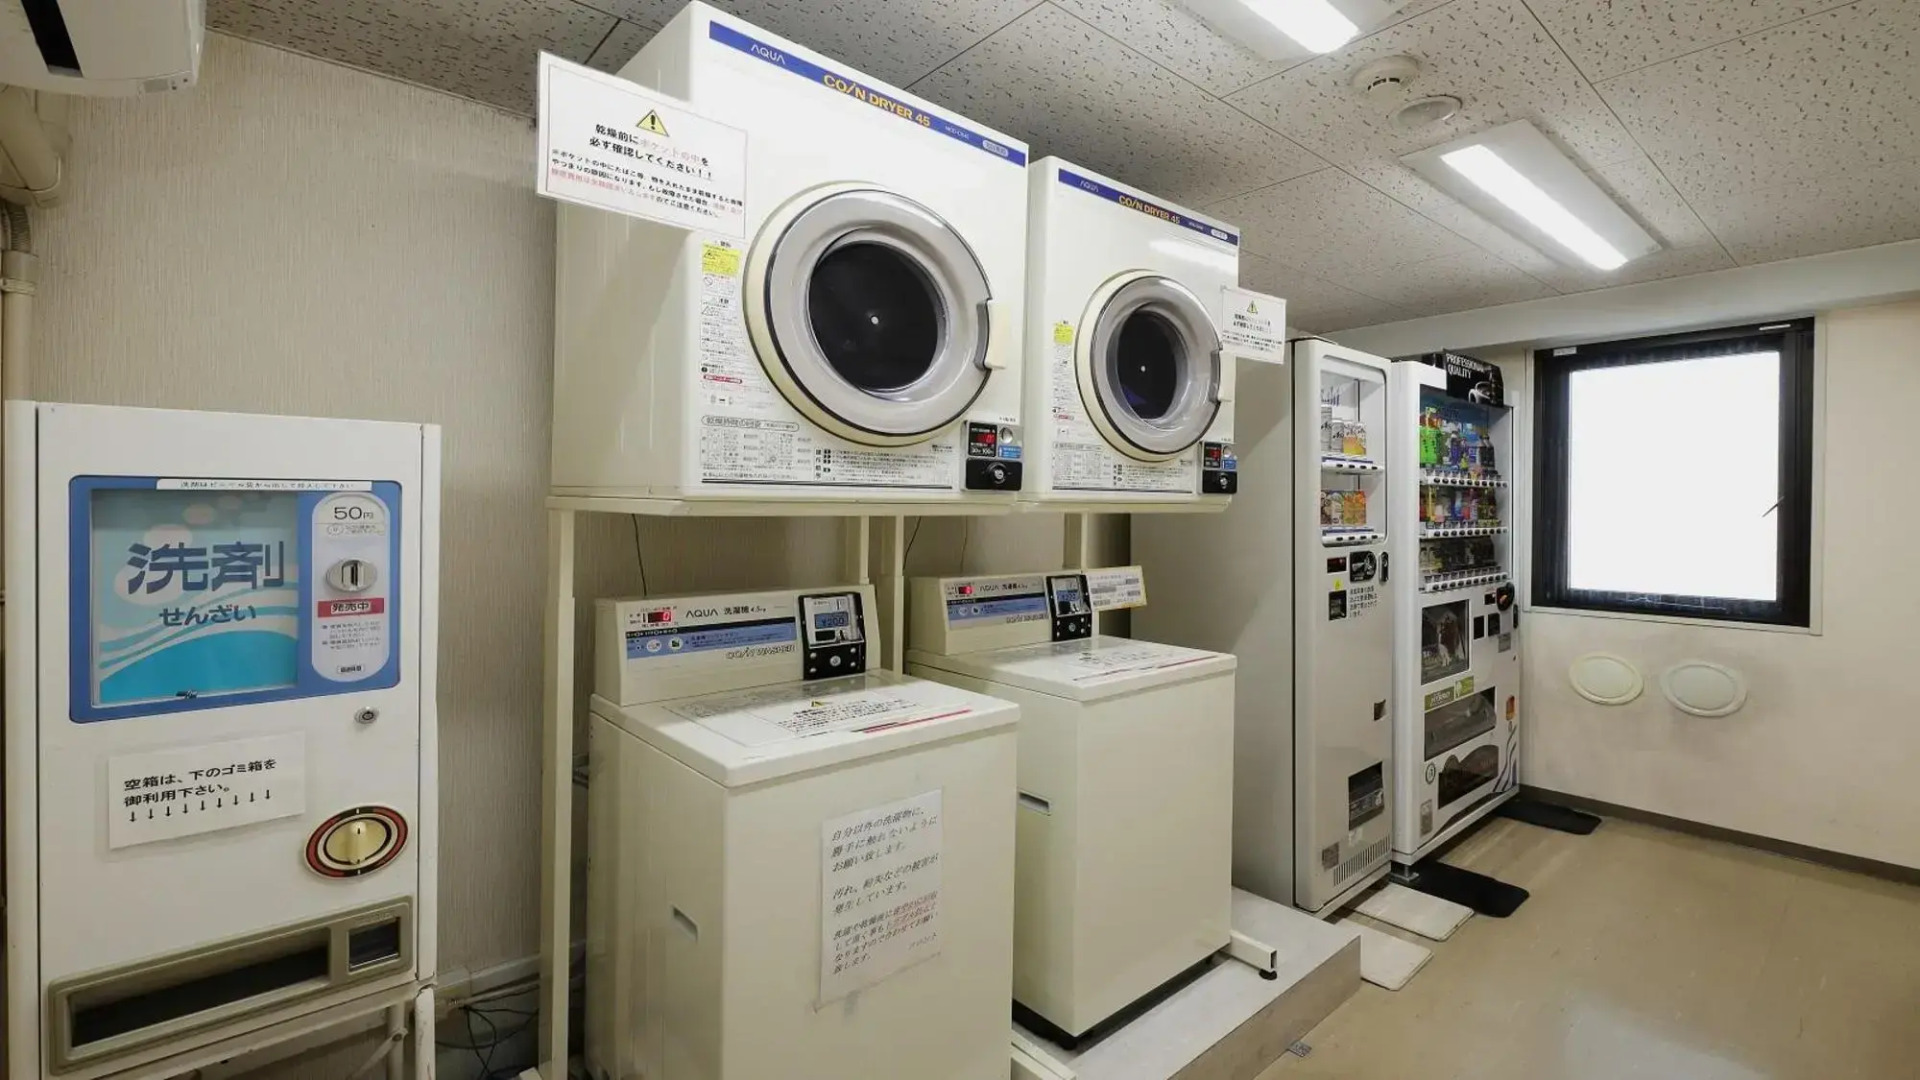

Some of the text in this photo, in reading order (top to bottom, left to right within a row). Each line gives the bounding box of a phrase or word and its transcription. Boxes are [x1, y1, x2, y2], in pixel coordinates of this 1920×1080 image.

[868, 94, 913, 120] DRYER
[914, 112, 931, 128] 45
[595, 123, 709, 167] 乾燥前にポケットの中を
[1144, 204, 1170, 221] DRYER
[1447, 364, 1471, 379] QUALITY
[334, 506, 374, 520] 50円
[127, 541, 285, 595] 洗剤
[158, 604, 257, 627] せんざい
[332, 600, 370, 612] 発売中
[686, 609, 719, 618] AQUA
[123, 758, 277, 791] 空箱は、下のゴミ箱を
[123, 784, 230, 807] 御利用下さい。
[834, 881, 907, 915] 発生しています。
